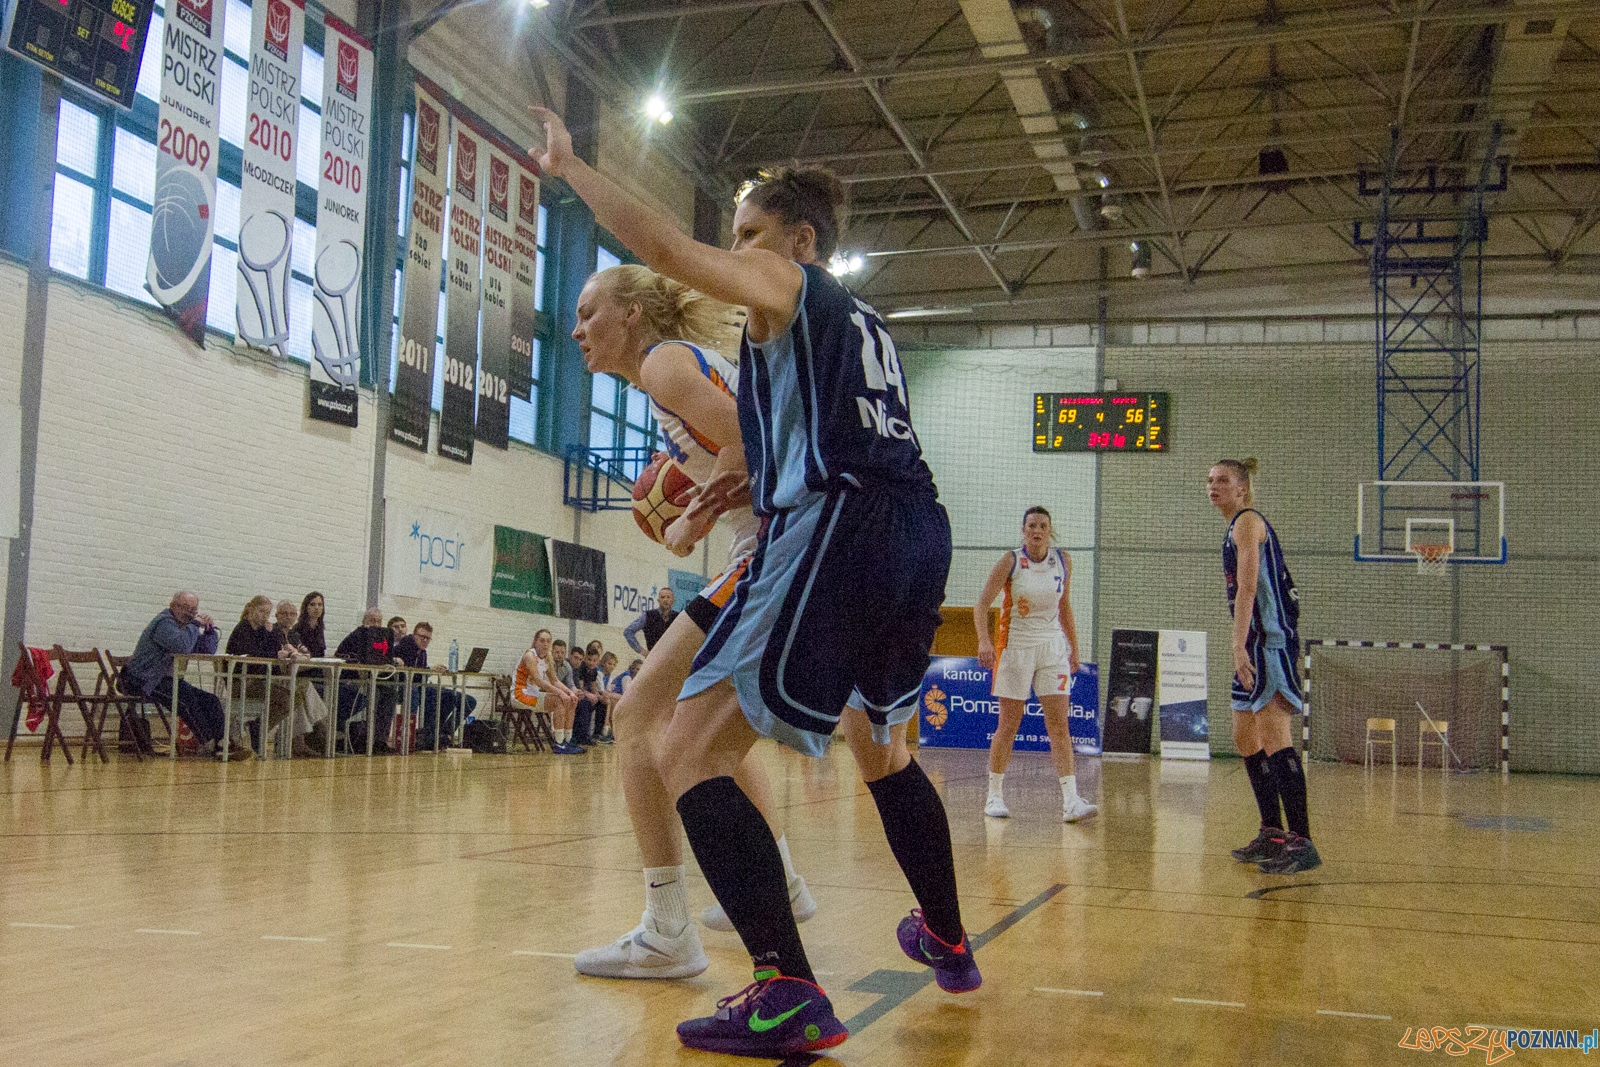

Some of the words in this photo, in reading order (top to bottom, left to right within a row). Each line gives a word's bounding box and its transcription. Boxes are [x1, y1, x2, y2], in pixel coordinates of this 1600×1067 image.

[165, 23, 217, 76] MISTRZ
[163, 53, 215, 106] POLSKI
[251, 52, 296, 99] MISTRZ
[162, 94, 211, 128] JUNIOREK
[250, 80, 295, 125] POLSKI
[325, 95, 365, 135] MISTRZ
[159, 118, 210, 172] 2009
[249, 112, 292, 161] 2010
[325, 121, 364, 160] POLSKI
[243, 159, 295, 197] MŁODZICZEK
[323, 150, 361, 193] 2010
[323, 198, 360, 224] JUNIOREK
[413, 200, 441, 234] OLSKI
[399, 335, 428, 374] 2011
[510, 334, 531, 357] 2013
[444, 355, 473, 391] 2012
[479, 370, 507, 404] 2012
[1058, 408, 1077, 424] 69
[1095, 411, 1105, 423] 4
[1125, 408, 1144, 424] 56
[1053, 435, 1063, 448] 2
[1135, 435, 1146, 448] 2
[419, 531, 465, 573] posir
[1053, 575, 1063, 593] 7
[943, 667, 988, 682] kantor
[1057, 673, 1069, 691] 7
[1026, 734, 1038, 742] na
[1067, 735, 1096, 745] tronę
